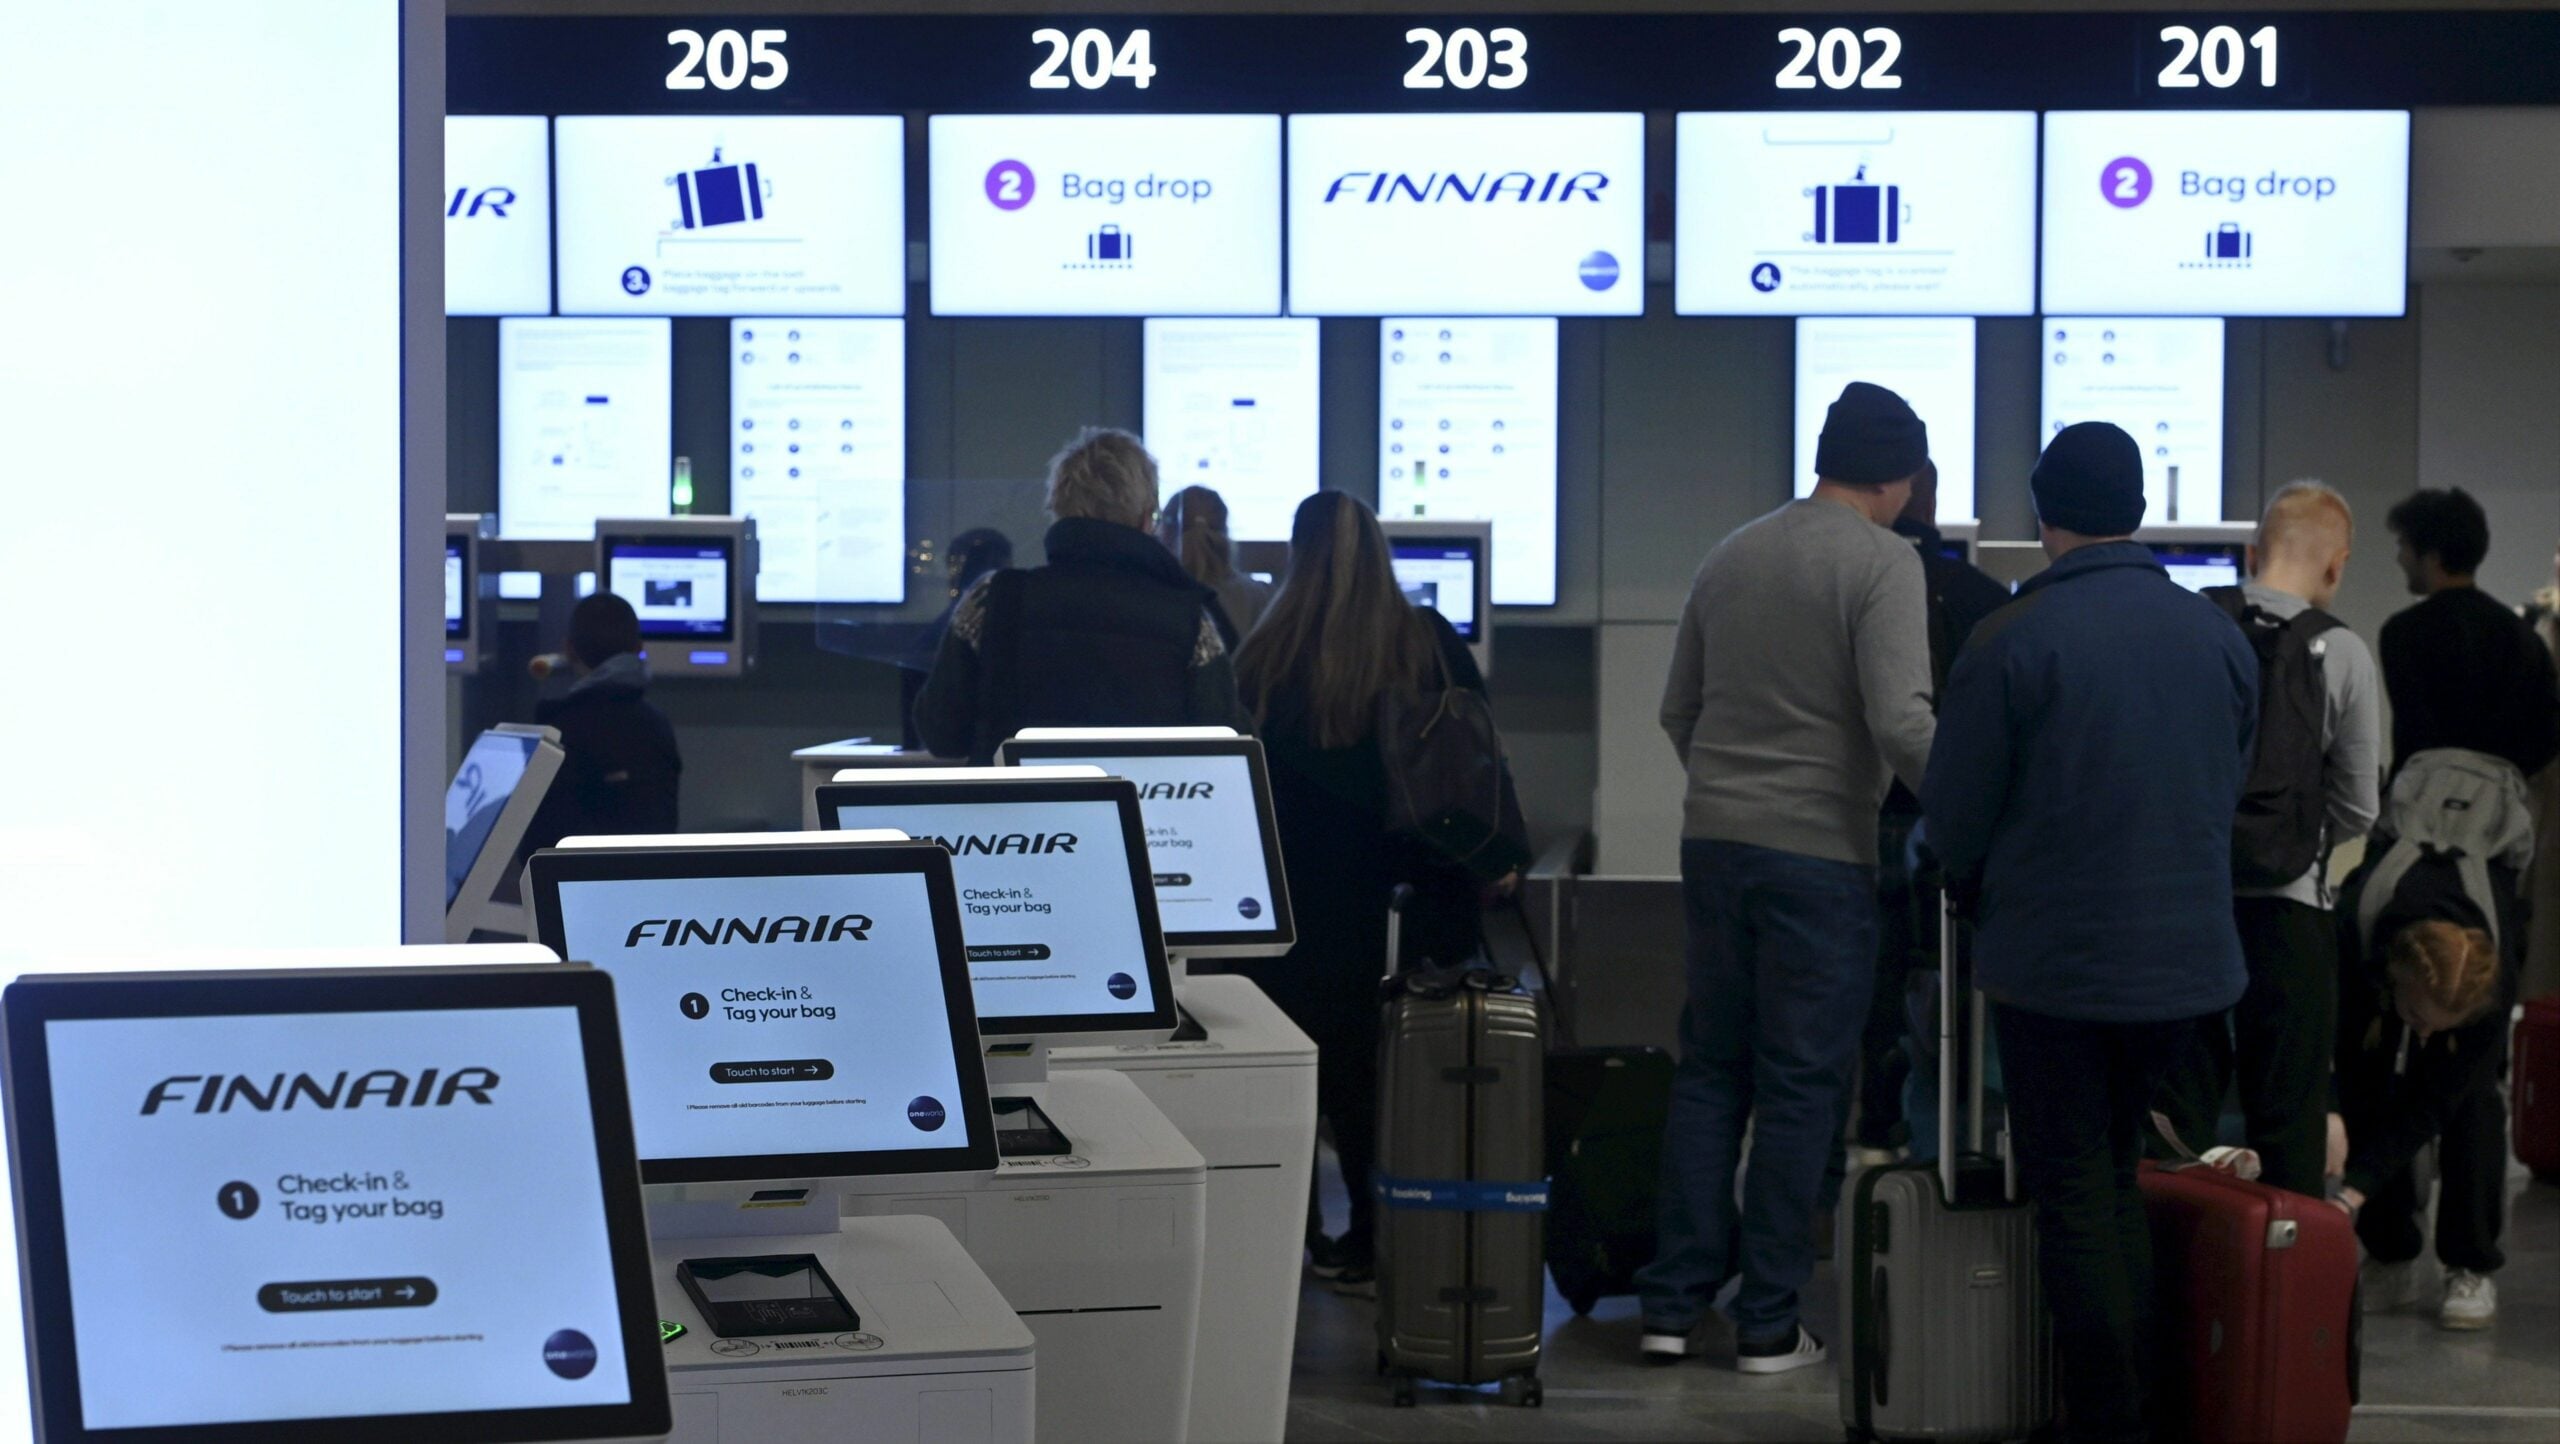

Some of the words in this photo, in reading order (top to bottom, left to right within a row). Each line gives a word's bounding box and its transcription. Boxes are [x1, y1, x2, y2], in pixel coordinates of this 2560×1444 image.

[666, 28, 788, 90] 205
[1030, 29, 1157, 90] 204
[1404, 28, 1528, 90] 203
[1776, 27, 1902, 89] 202
[2158, 26, 2277, 89] 201
[998, 169, 1022, 201] 2
[1064, 174, 1125, 205] Bag
[1135, 173, 1212, 204] drop
[1324, 171, 1610, 203] FINNAIR
[2114, 167, 2138, 199] 2
[2180, 171, 2246, 203] Bag
[2256, 171, 2336, 203] drop
[910, 833, 1078, 856] NNAIR
[963, 887, 1021, 900] Check-in
[1024, 887, 1033, 899] &
[965, 903, 991, 916] Tag
[992, 904, 1022, 916] your
[1024, 902, 1052, 915] bag
[625, 914, 873, 948] FINNAIR
[968, 949, 993, 958] Touch
[993, 949, 1002, 957] to
[1003, 948, 1021, 957] start
[721, 986, 797, 1002] Check-in
[800, 985, 813, 999] &
[723, 1006, 756, 1023] Tag
[759, 1007, 798, 1022] your
[800, 1004, 837, 1020] bag
[726, 1067, 757, 1078] Touch
[758, 1067, 770, 1077] to
[771, 1066, 796, 1076] start
[140, 1066, 501, 1116] FINNAIR
[908, 1109, 944, 1118] oneworld
[277, 1172, 388, 1194] Check-in
[393, 1170, 410, 1190] &
[280, 1200, 328, 1225] Tag
[332, 1202, 388, 1223] your
[393, 1197, 444, 1220] bag
[280, 1289, 327, 1305] Touch
[328, 1288, 346, 1302] to
[347, 1286, 383, 1302] start
